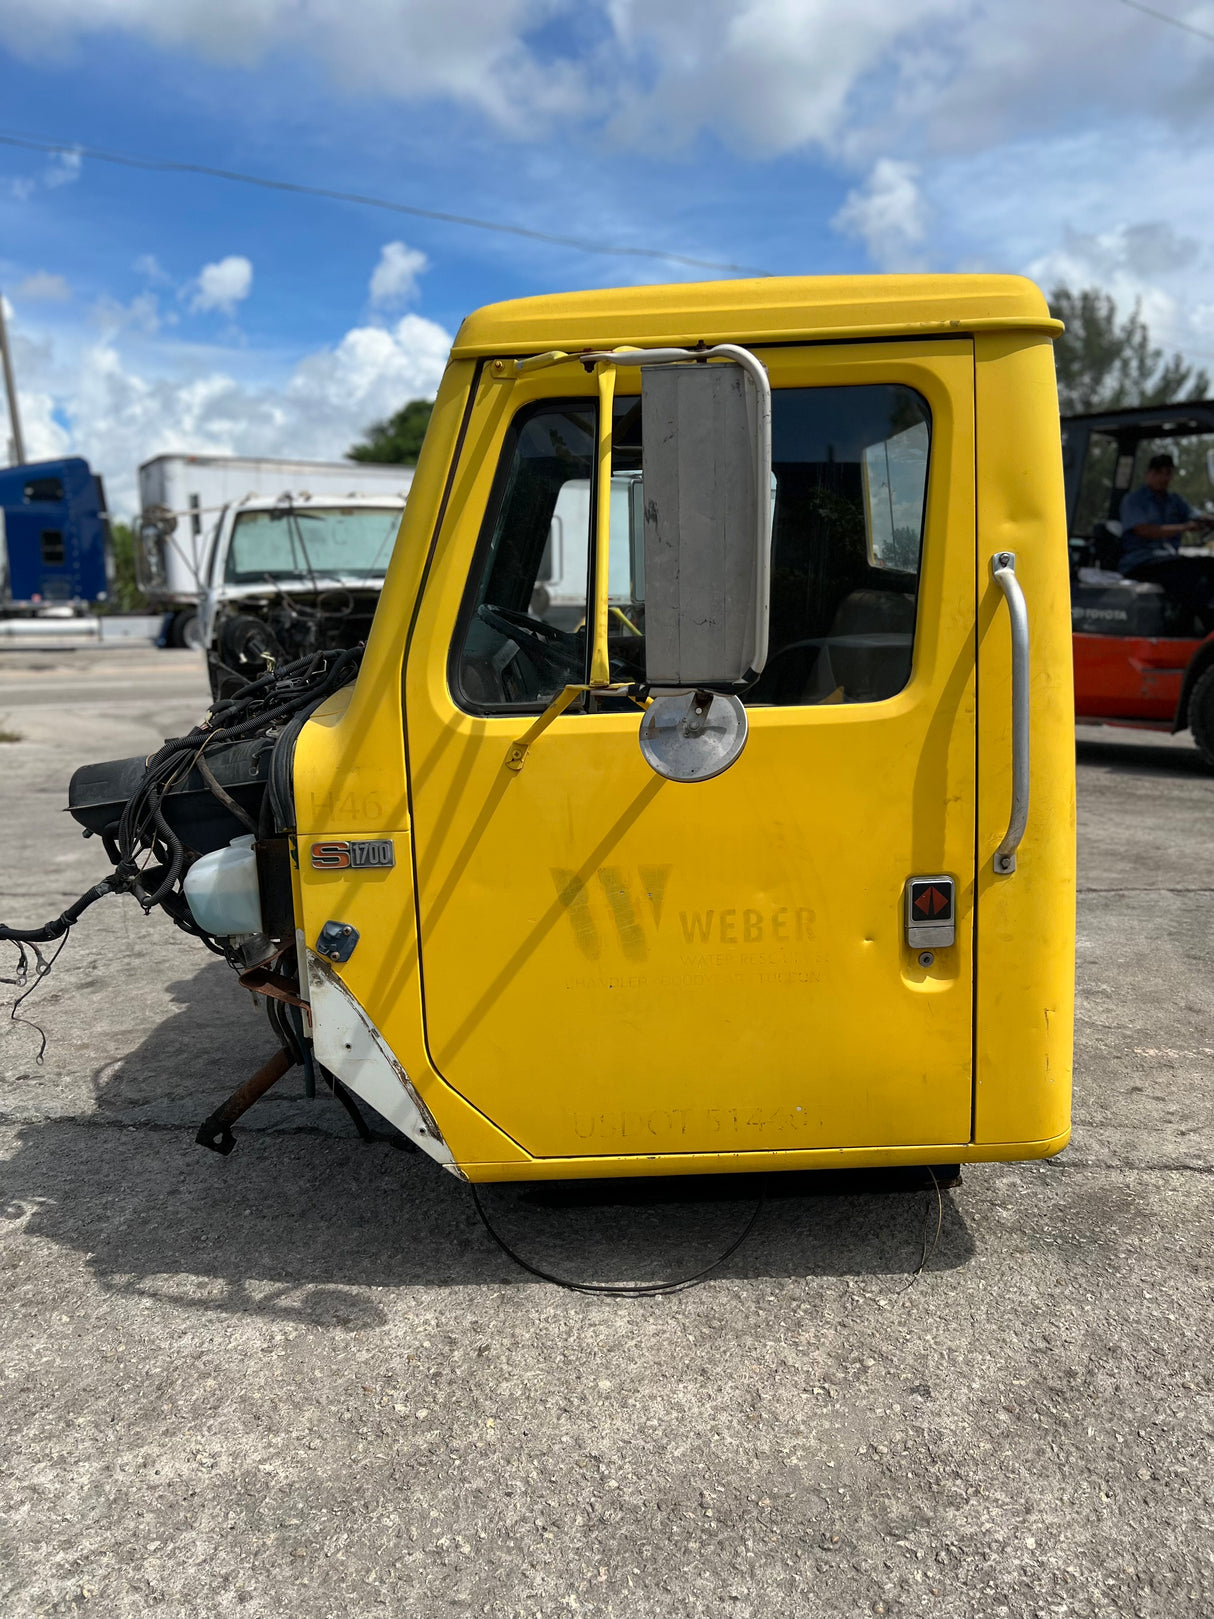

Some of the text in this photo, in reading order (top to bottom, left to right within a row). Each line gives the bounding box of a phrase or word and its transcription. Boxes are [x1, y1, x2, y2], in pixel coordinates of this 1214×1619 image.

[1085, 608, 1128, 620] TOYOTA
[311, 841, 391, 869] S 1700
[678, 907, 817, 944] WEBER
